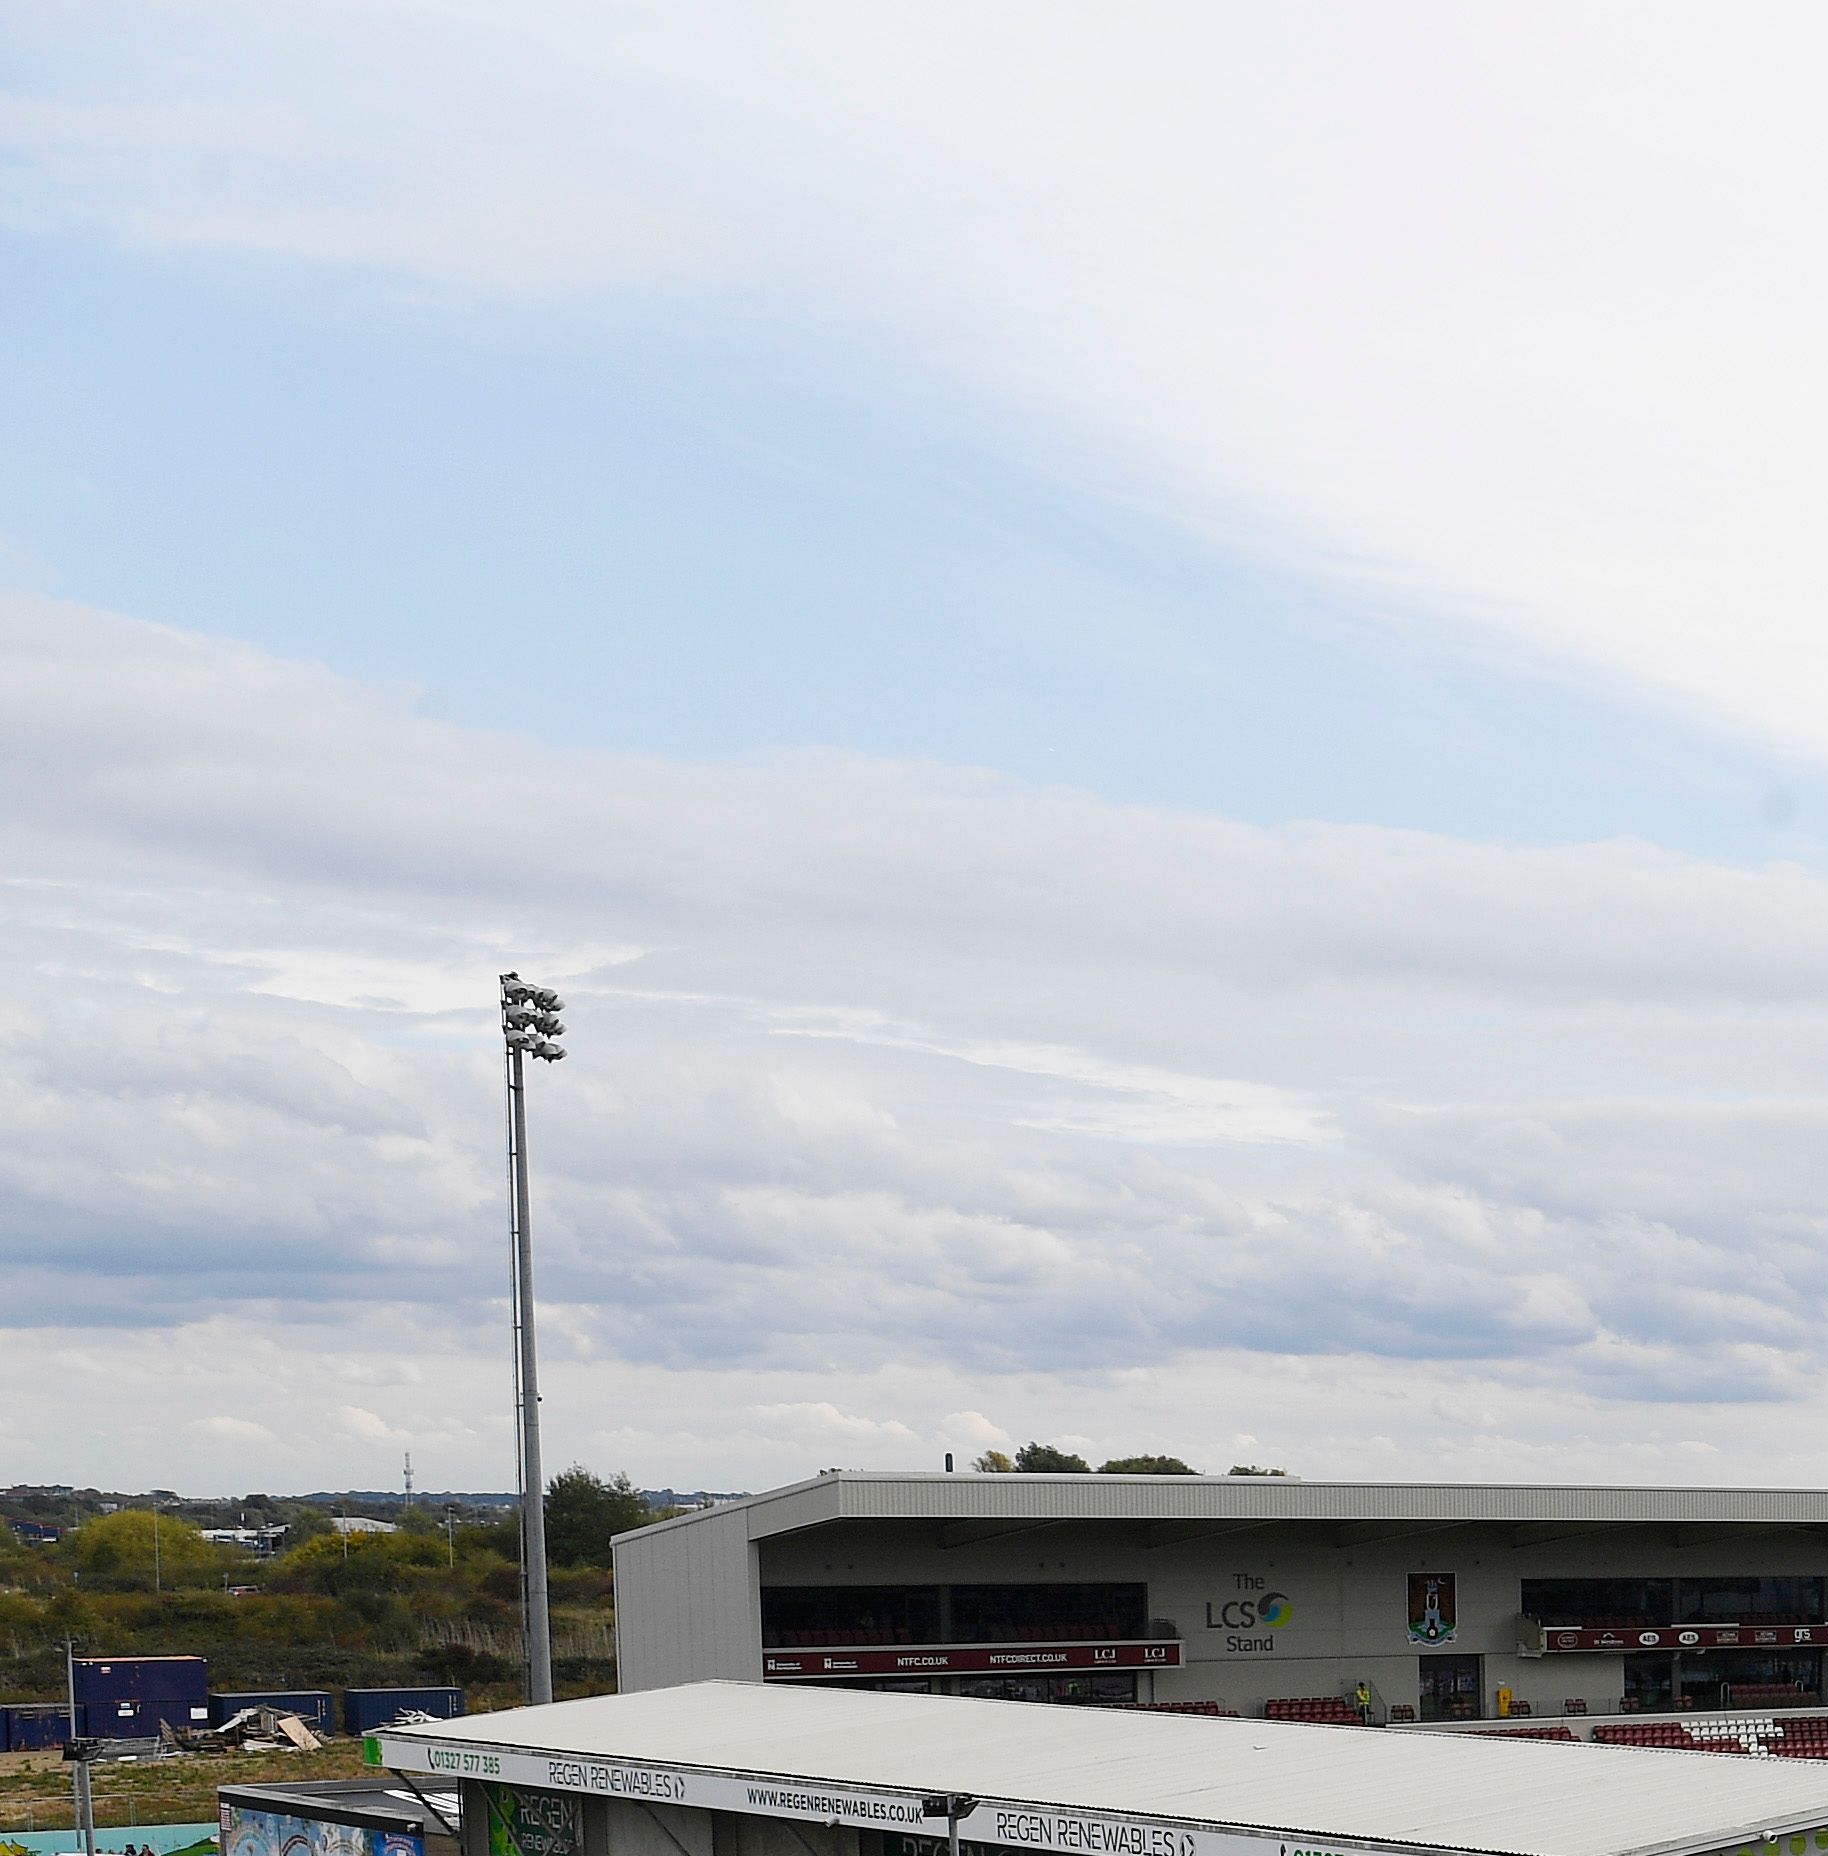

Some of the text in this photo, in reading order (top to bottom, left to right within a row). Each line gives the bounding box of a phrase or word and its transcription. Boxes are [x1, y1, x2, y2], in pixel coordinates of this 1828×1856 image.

[1233, 1573, 1265, 1590] The
[1206, 1601, 1255, 1628] LCS
[1226, 1635, 1274, 1652] Stand
[897, 1656, 949, 1667] NTFC.CO.UK
[434, 1750, 501, 1775] 01327 577 385
[548, 1761, 671, 1798] REGEN RENEWABLES
[747, 1787, 924, 1825] WWW.REGENRENEWABLES.CO.UK
[996, 1812, 1052, 1843] REGEN
